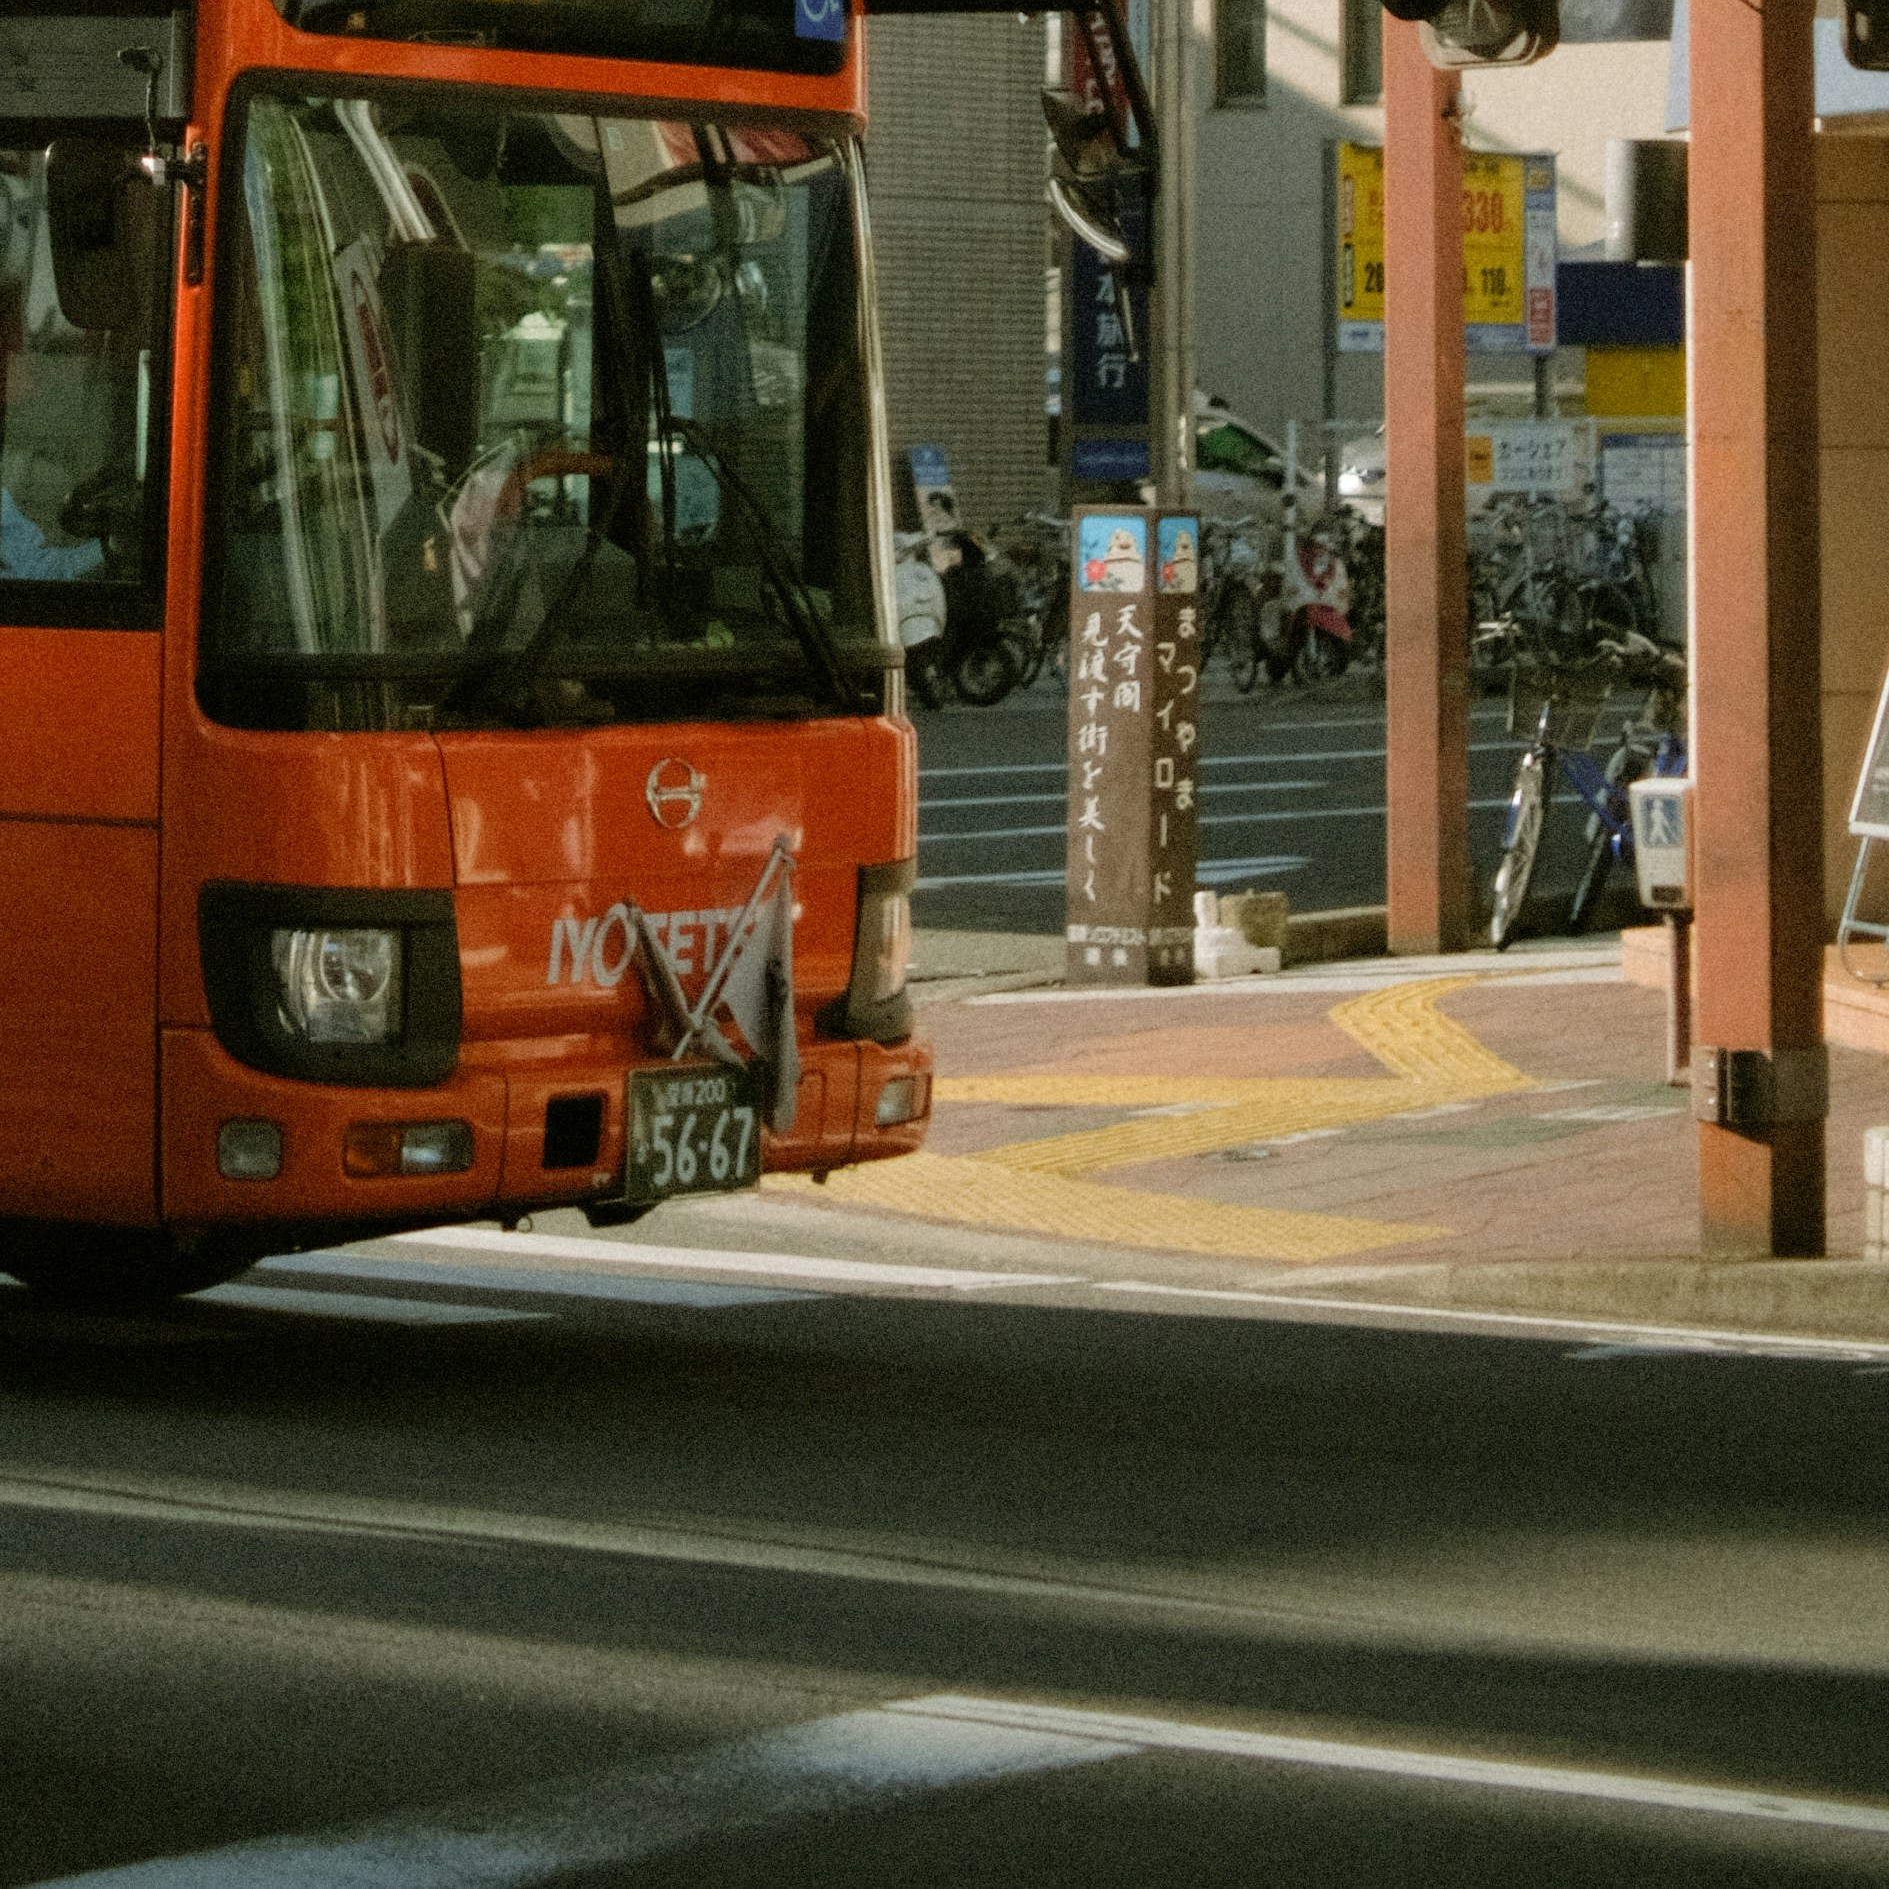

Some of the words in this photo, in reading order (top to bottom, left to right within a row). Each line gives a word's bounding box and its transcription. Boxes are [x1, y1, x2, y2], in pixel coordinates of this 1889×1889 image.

[1155, 641, 1176, 905] マイロード
[1175, 606, 1197, 811] まつやま
